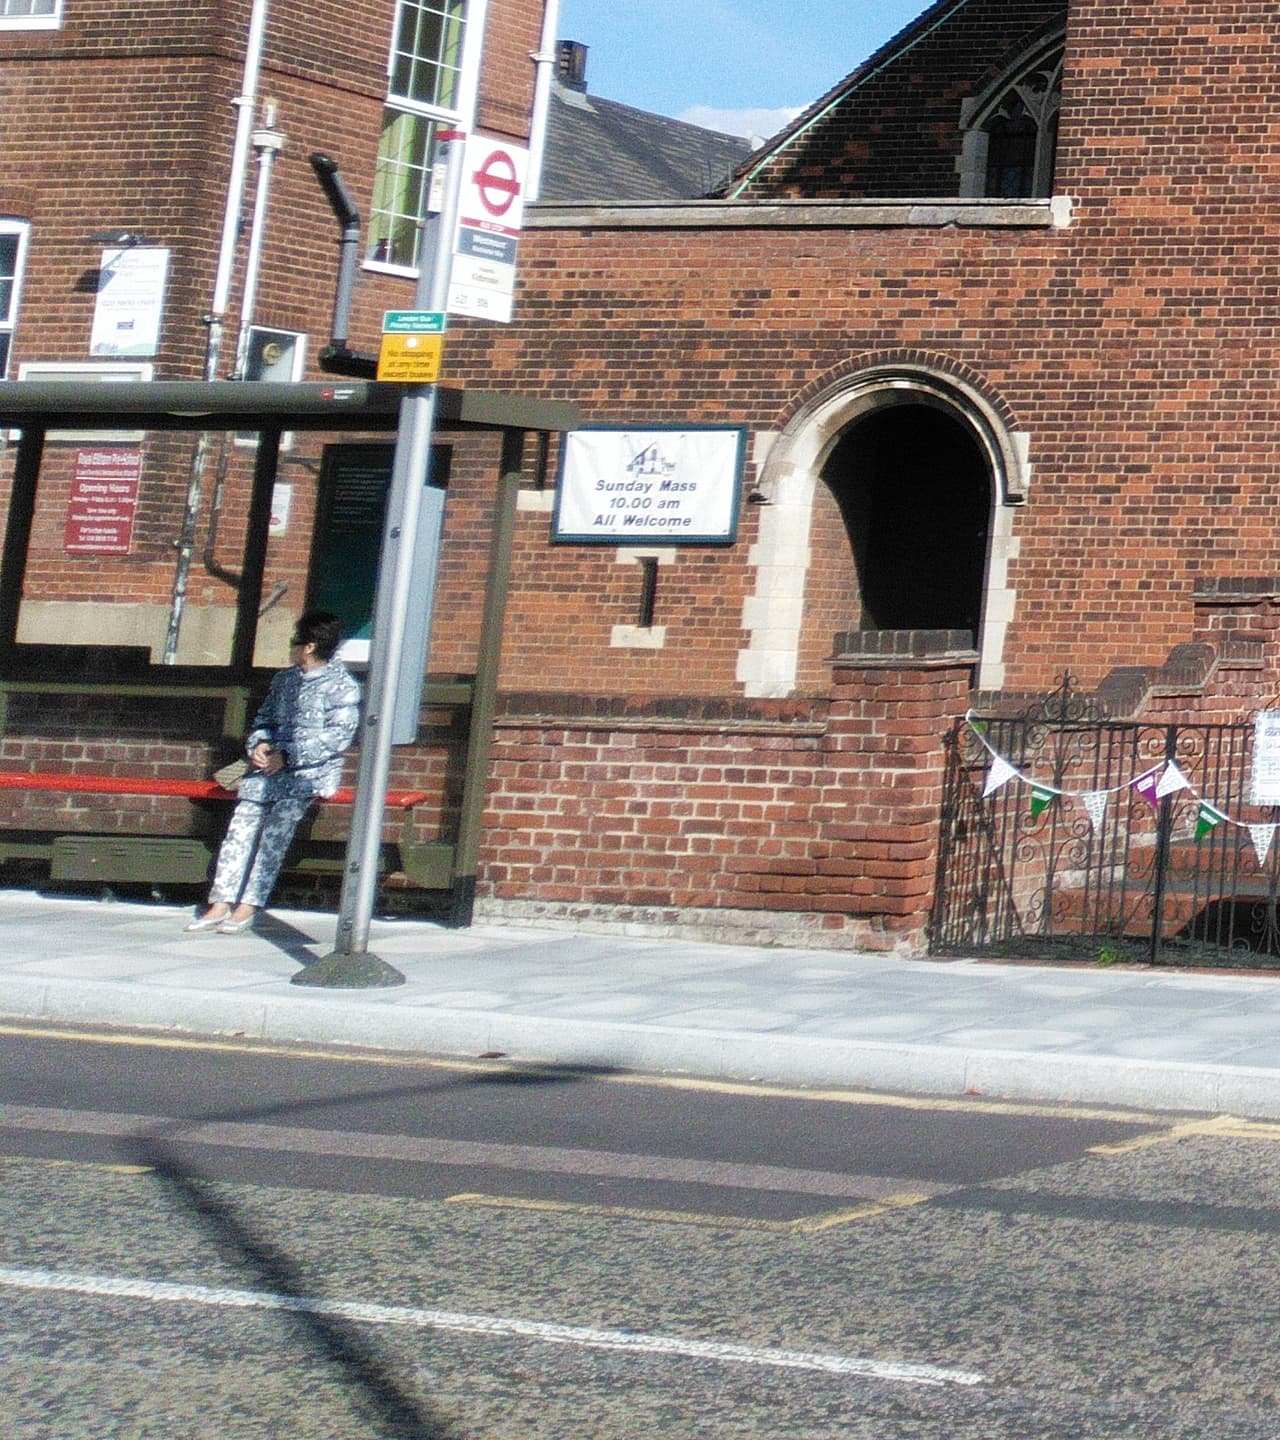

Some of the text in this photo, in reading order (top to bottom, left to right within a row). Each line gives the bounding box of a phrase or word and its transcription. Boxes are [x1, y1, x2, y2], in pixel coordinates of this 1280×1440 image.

[401, 351, 434, 360] stopping
[595, 479, 697, 493] Sunday Mass
[609, 497, 680, 509] 10.00 am
[593, 514, 692, 527] All Welcome
